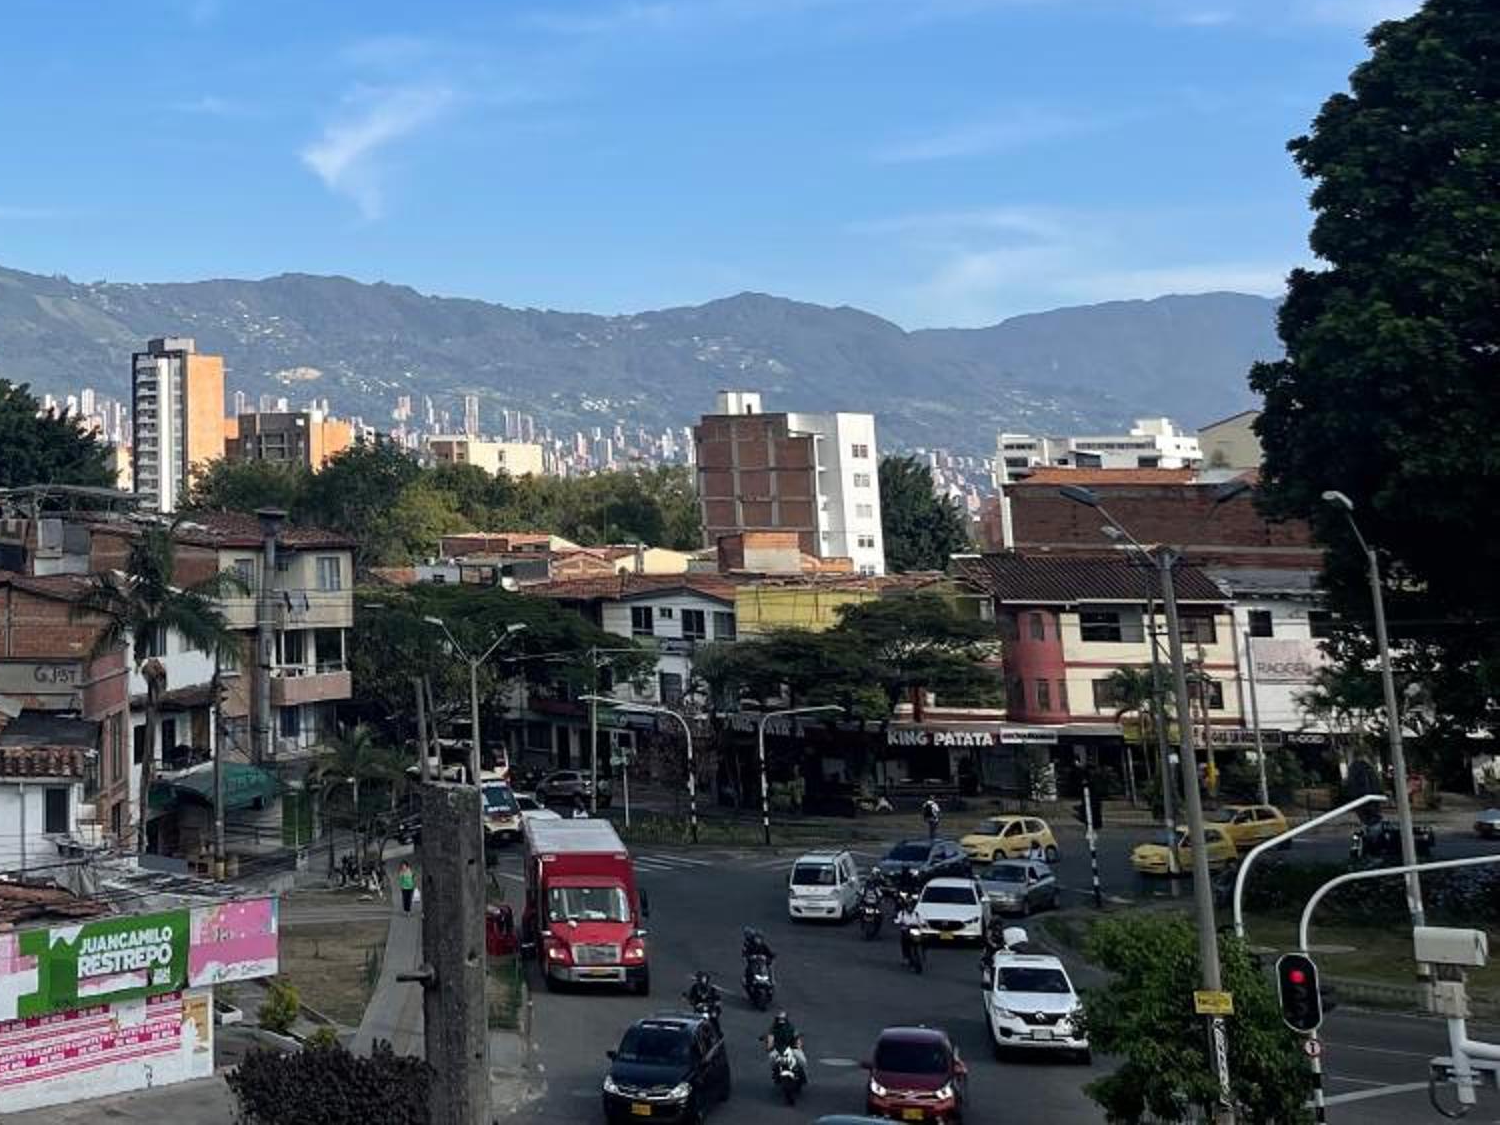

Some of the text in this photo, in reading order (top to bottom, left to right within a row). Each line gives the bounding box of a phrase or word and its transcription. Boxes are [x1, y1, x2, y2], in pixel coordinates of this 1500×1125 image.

[887, 731, 928, 746] KING
[933, 731, 995, 747] PATATA
[77, 942, 173, 979] RESTREPO
